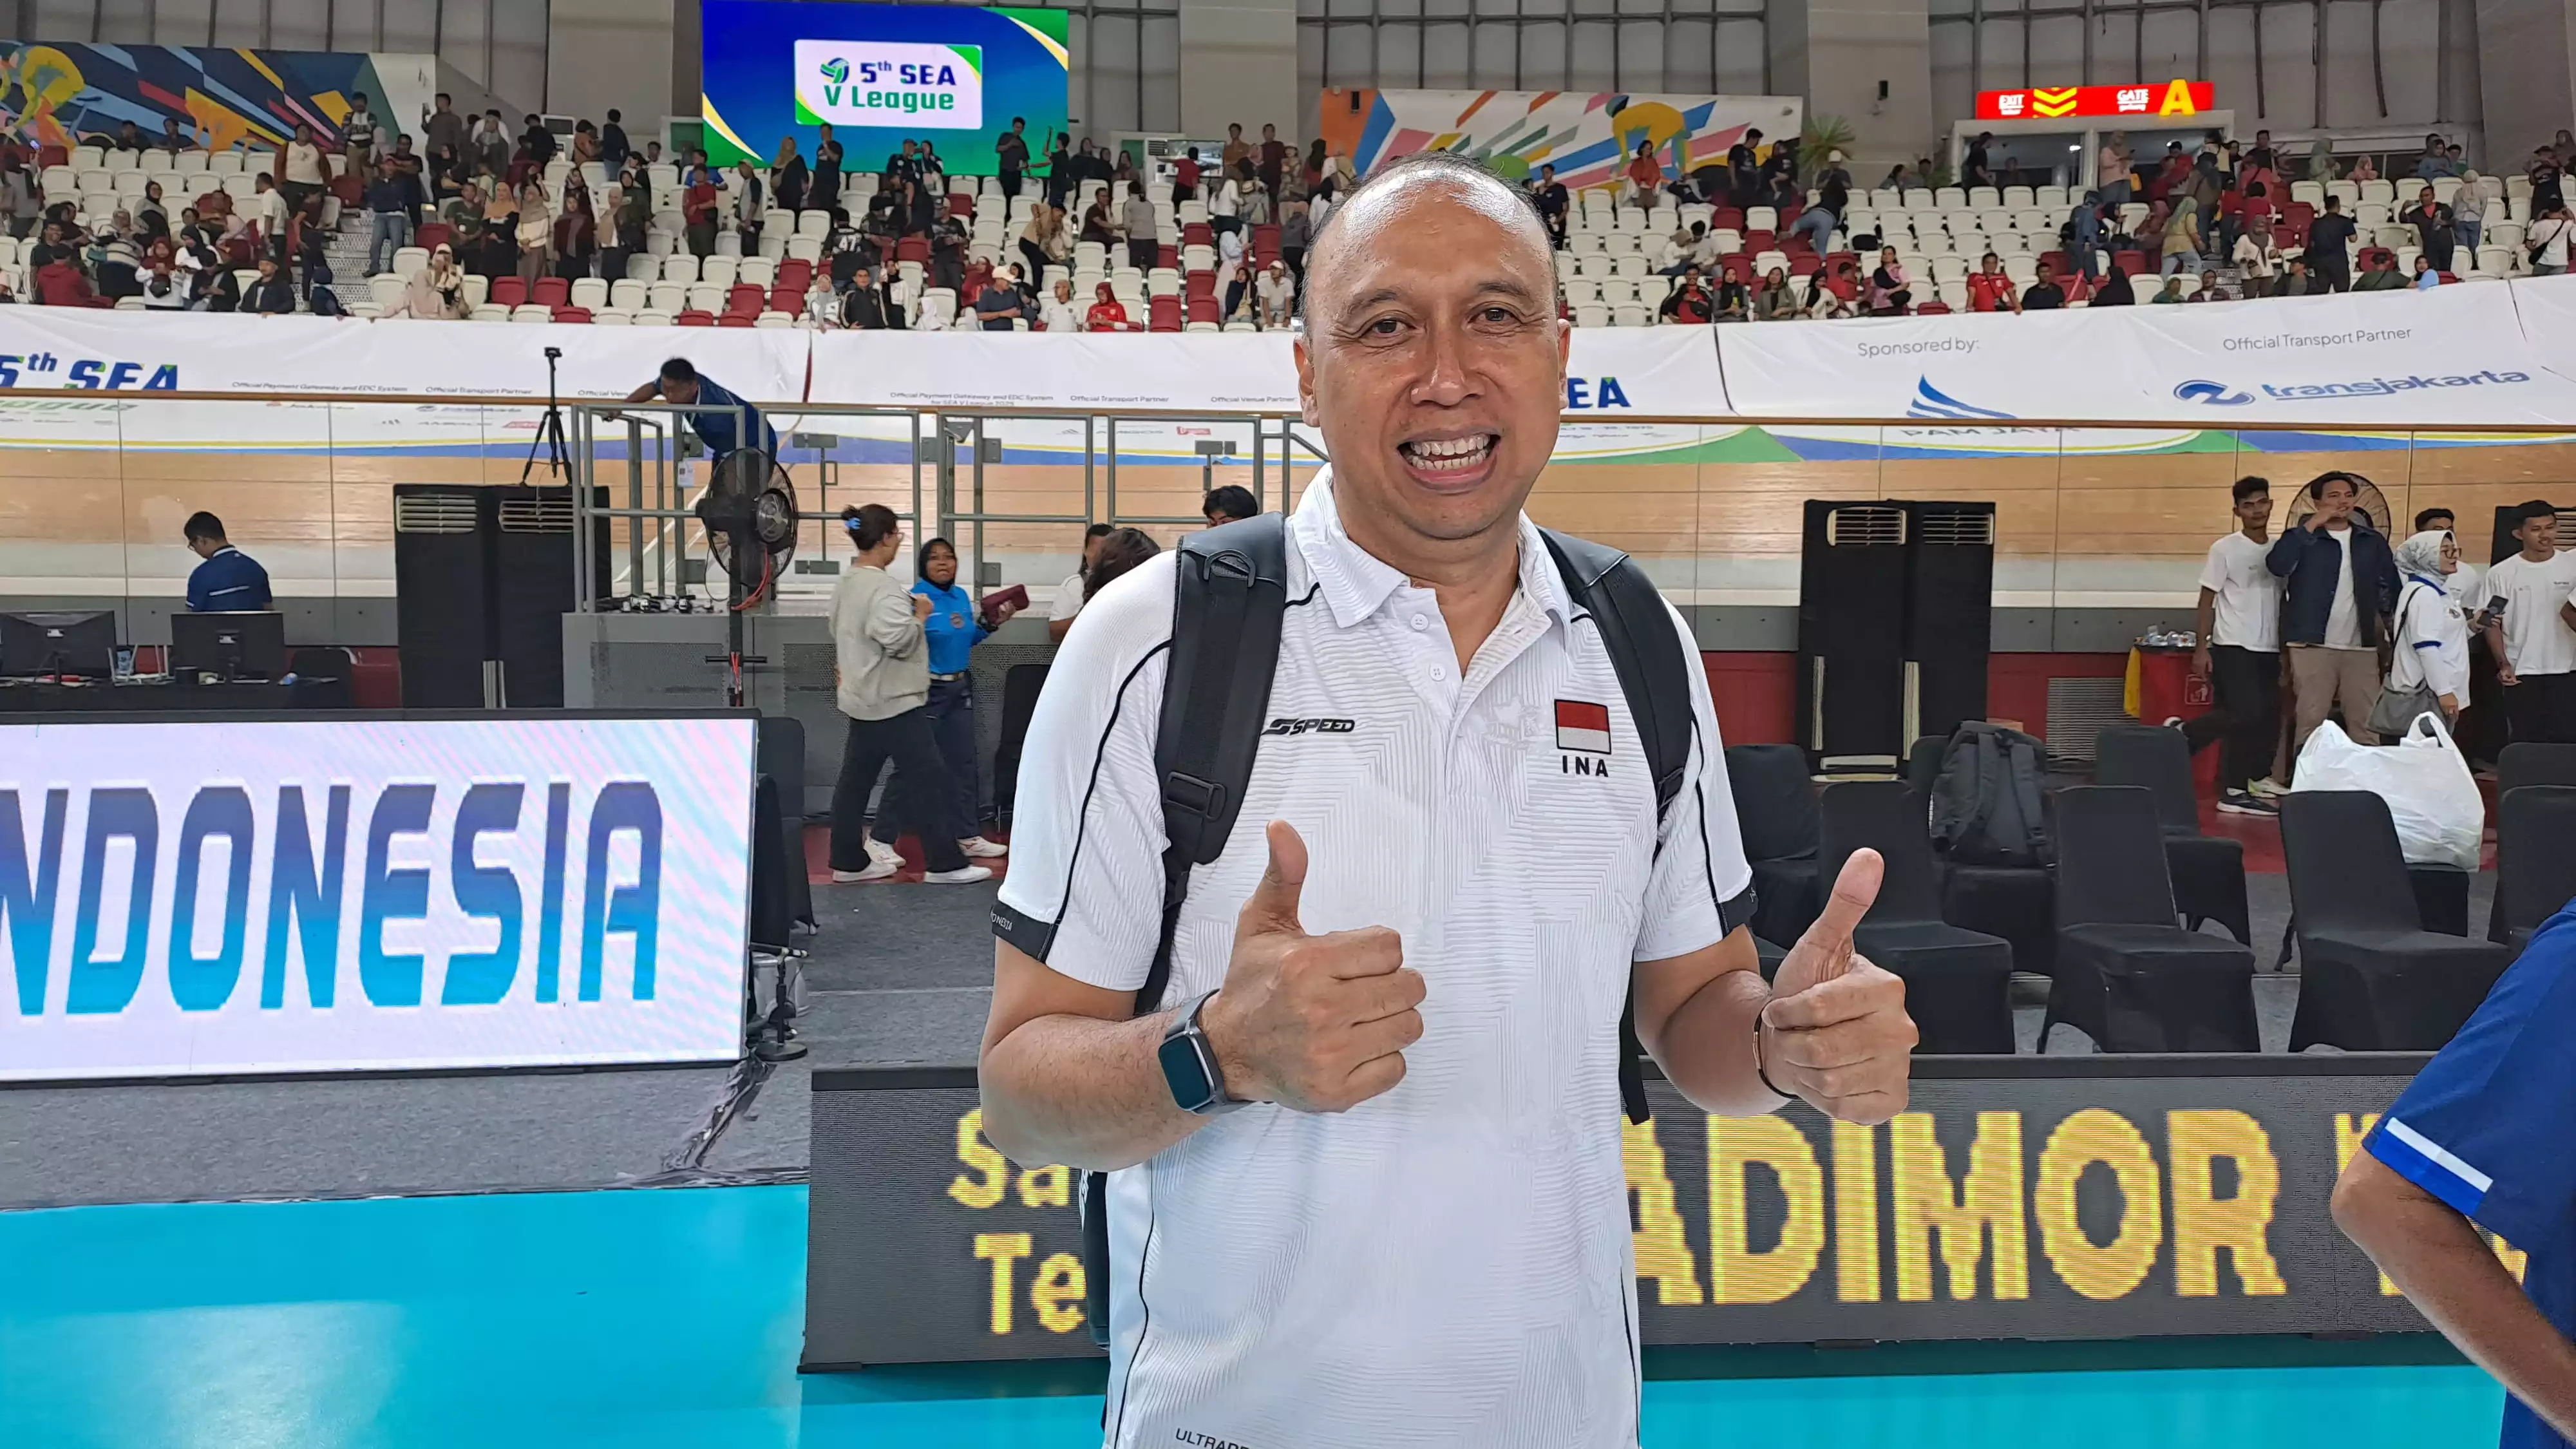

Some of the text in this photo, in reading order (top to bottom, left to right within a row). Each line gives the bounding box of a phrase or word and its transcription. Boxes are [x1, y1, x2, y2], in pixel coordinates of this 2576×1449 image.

[860, 61, 956, 85] 5th SEA
[824, 85, 954, 113] V League
[1998, 94, 2025, 108] EXIT
[2117, 79, 2195, 116] GATE A
[838, 235, 857, 251] 47
[1857, 337, 1980, 359] Sponsored by:
[2223, 327, 2412, 352] Official Transport Partner
[63, 359, 178, 391] SEA
[2261, 370, 2531, 401] transjakarta
[1562, 755, 1609, 778] INA
[0, 781, 663, 1015] NDONESIA
[1621, 1108, 2286, 1305] ADIMOR
[973, 1232, 1088, 1333] Te
